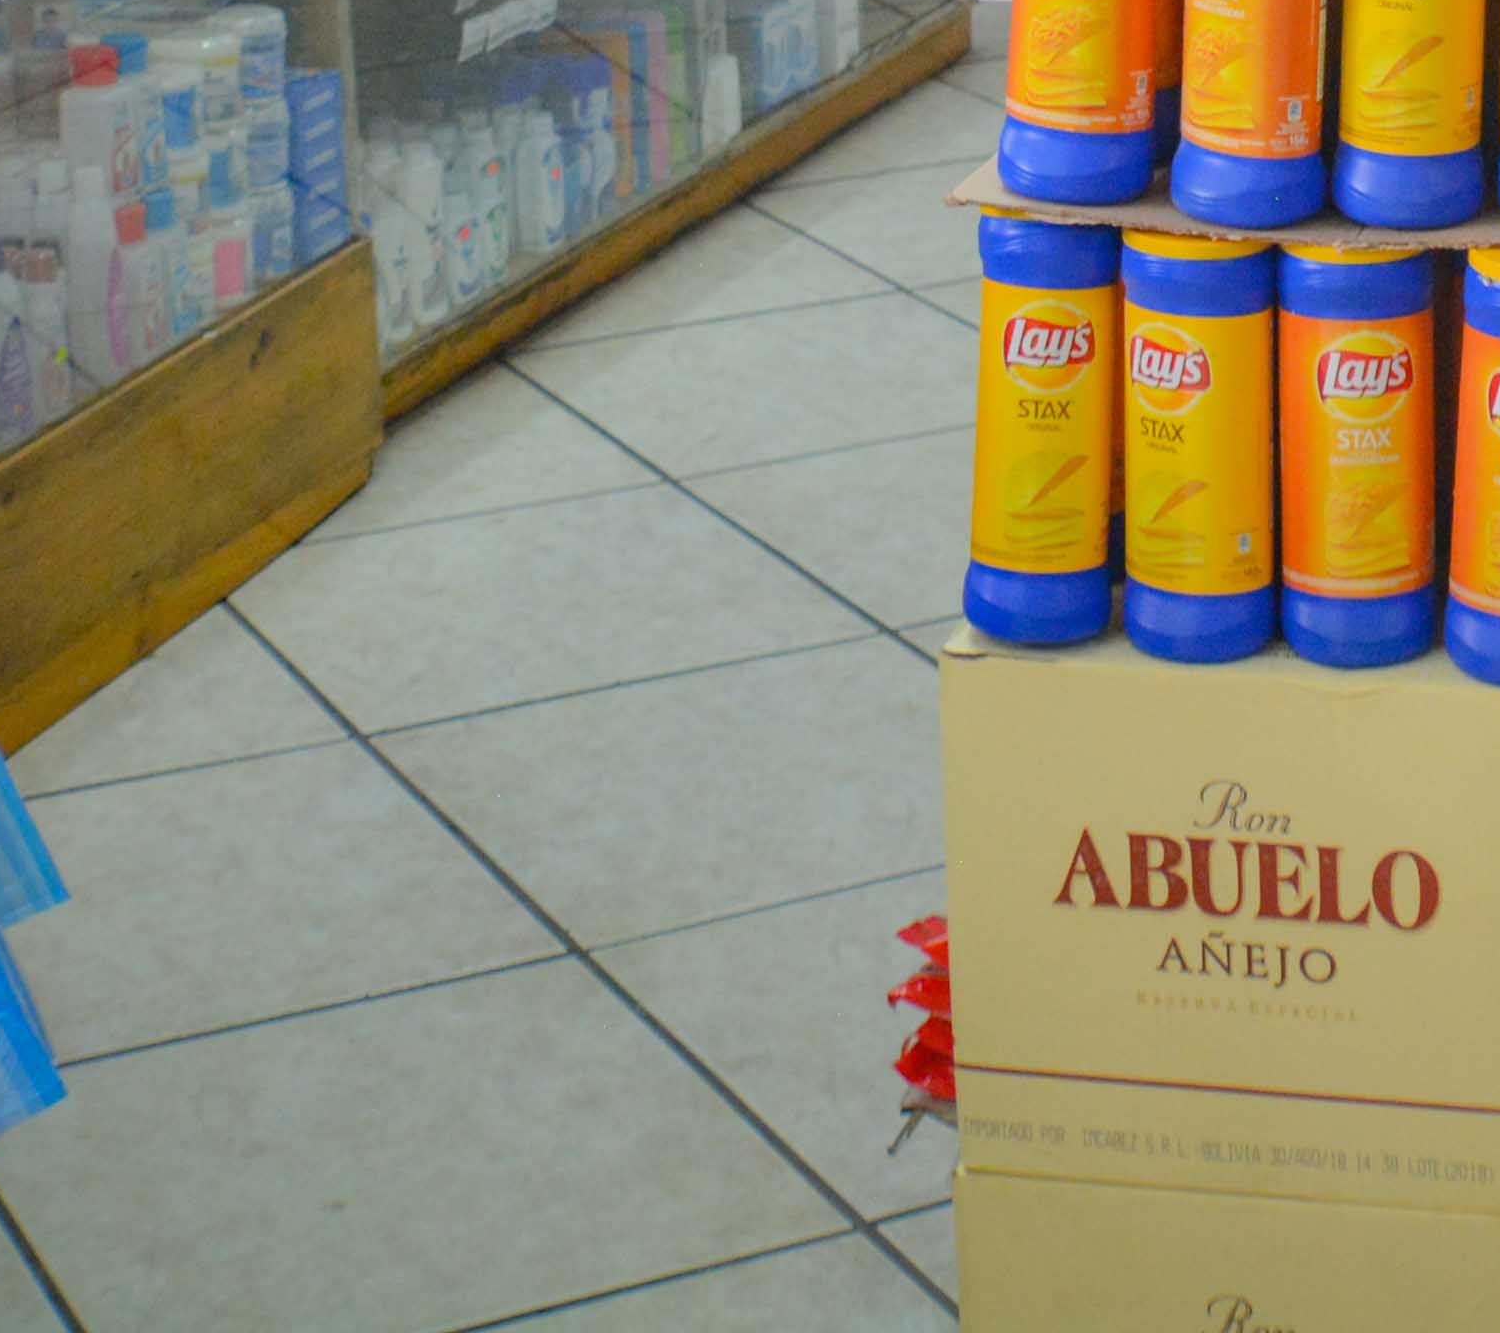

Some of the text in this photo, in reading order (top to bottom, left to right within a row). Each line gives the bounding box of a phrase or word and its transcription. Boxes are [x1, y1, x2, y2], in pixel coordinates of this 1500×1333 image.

[1005, 318, 1092, 367] Lay's
[1132, 335, 1207, 389] Lay's
[1321, 351, 1410, 399] Lay's
[1017, 399, 1071, 420] STAX
[1140, 417, 1186, 444] STAX
[1336, 428, 1392, 452] STAX
[1191, 778, 1293, 837] Ron
[1051, 825, 1443, 933] ABUELO
[1155, 931, 1340, 990] AÑEJO
